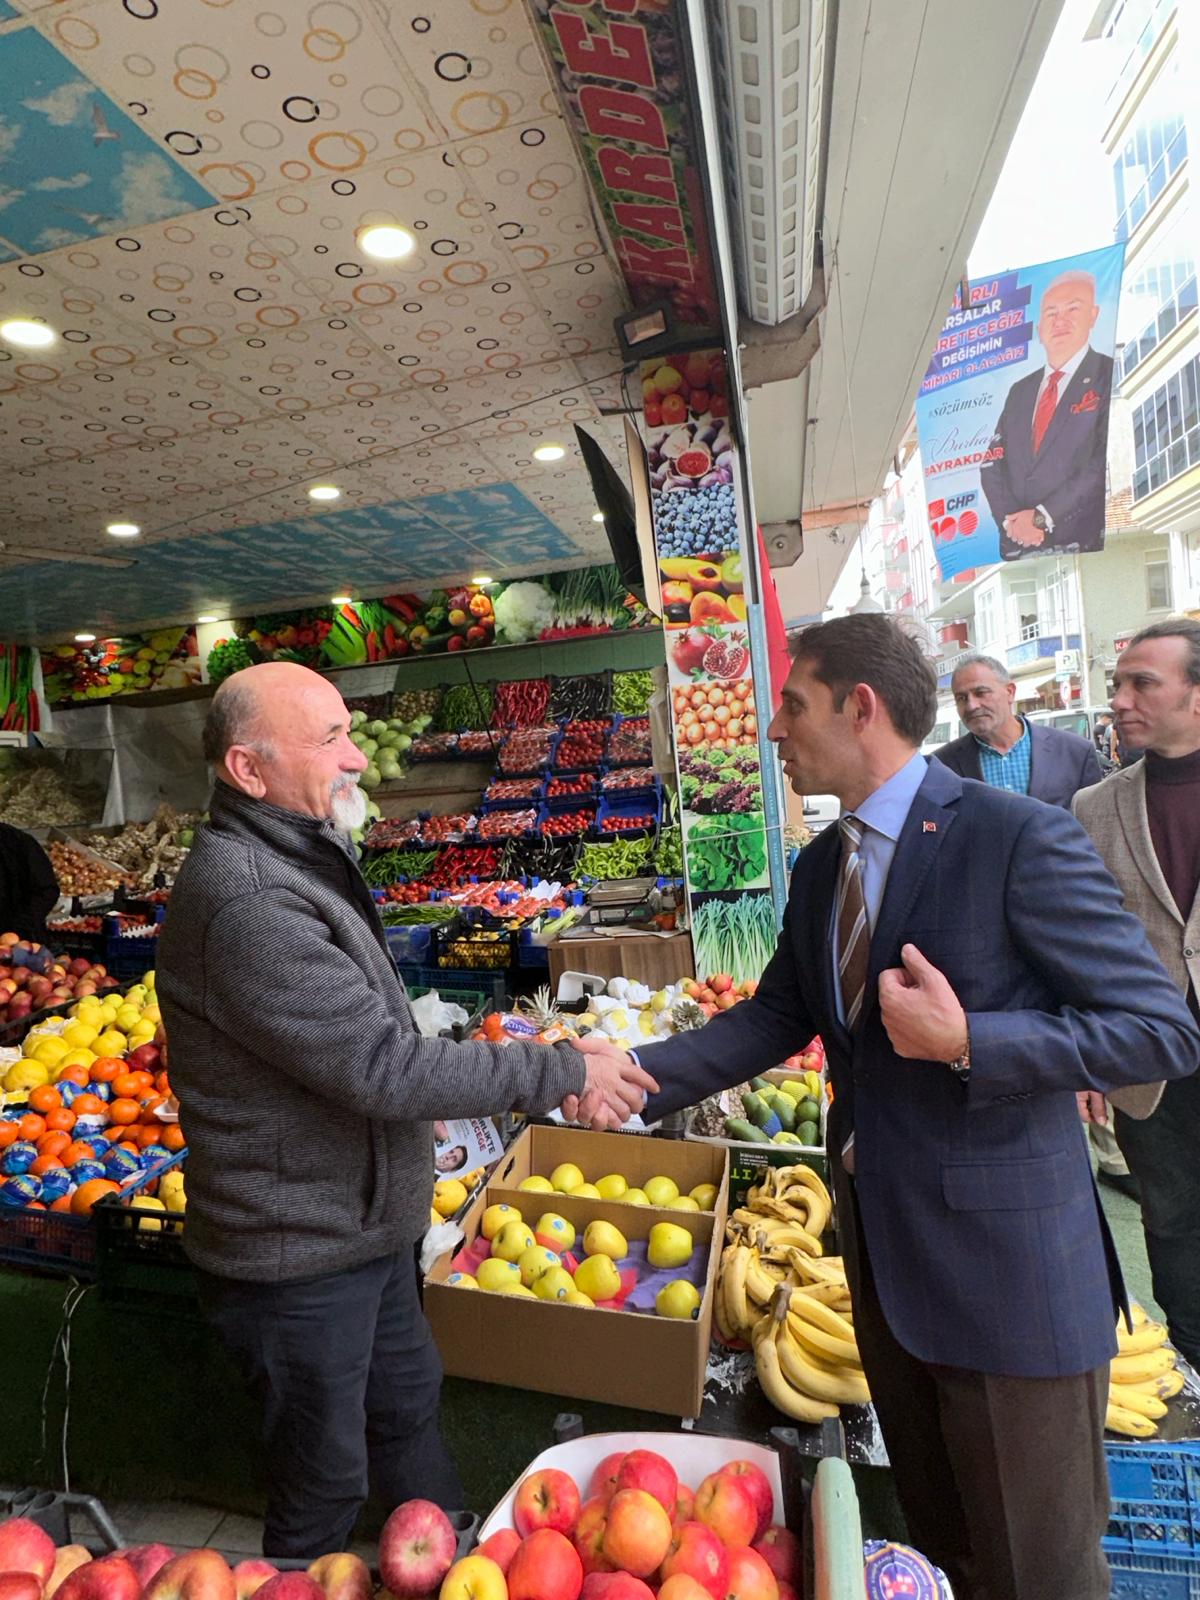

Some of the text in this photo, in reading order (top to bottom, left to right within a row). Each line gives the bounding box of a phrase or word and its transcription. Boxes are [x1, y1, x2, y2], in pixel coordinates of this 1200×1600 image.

[942, 299, 1002, 331] RSALAR
[942, 336, 1003, 368] DEĞİŞİMİN
[926, 426, 1003, 461] Burhan
[946, 493, 976, 511] CHP
